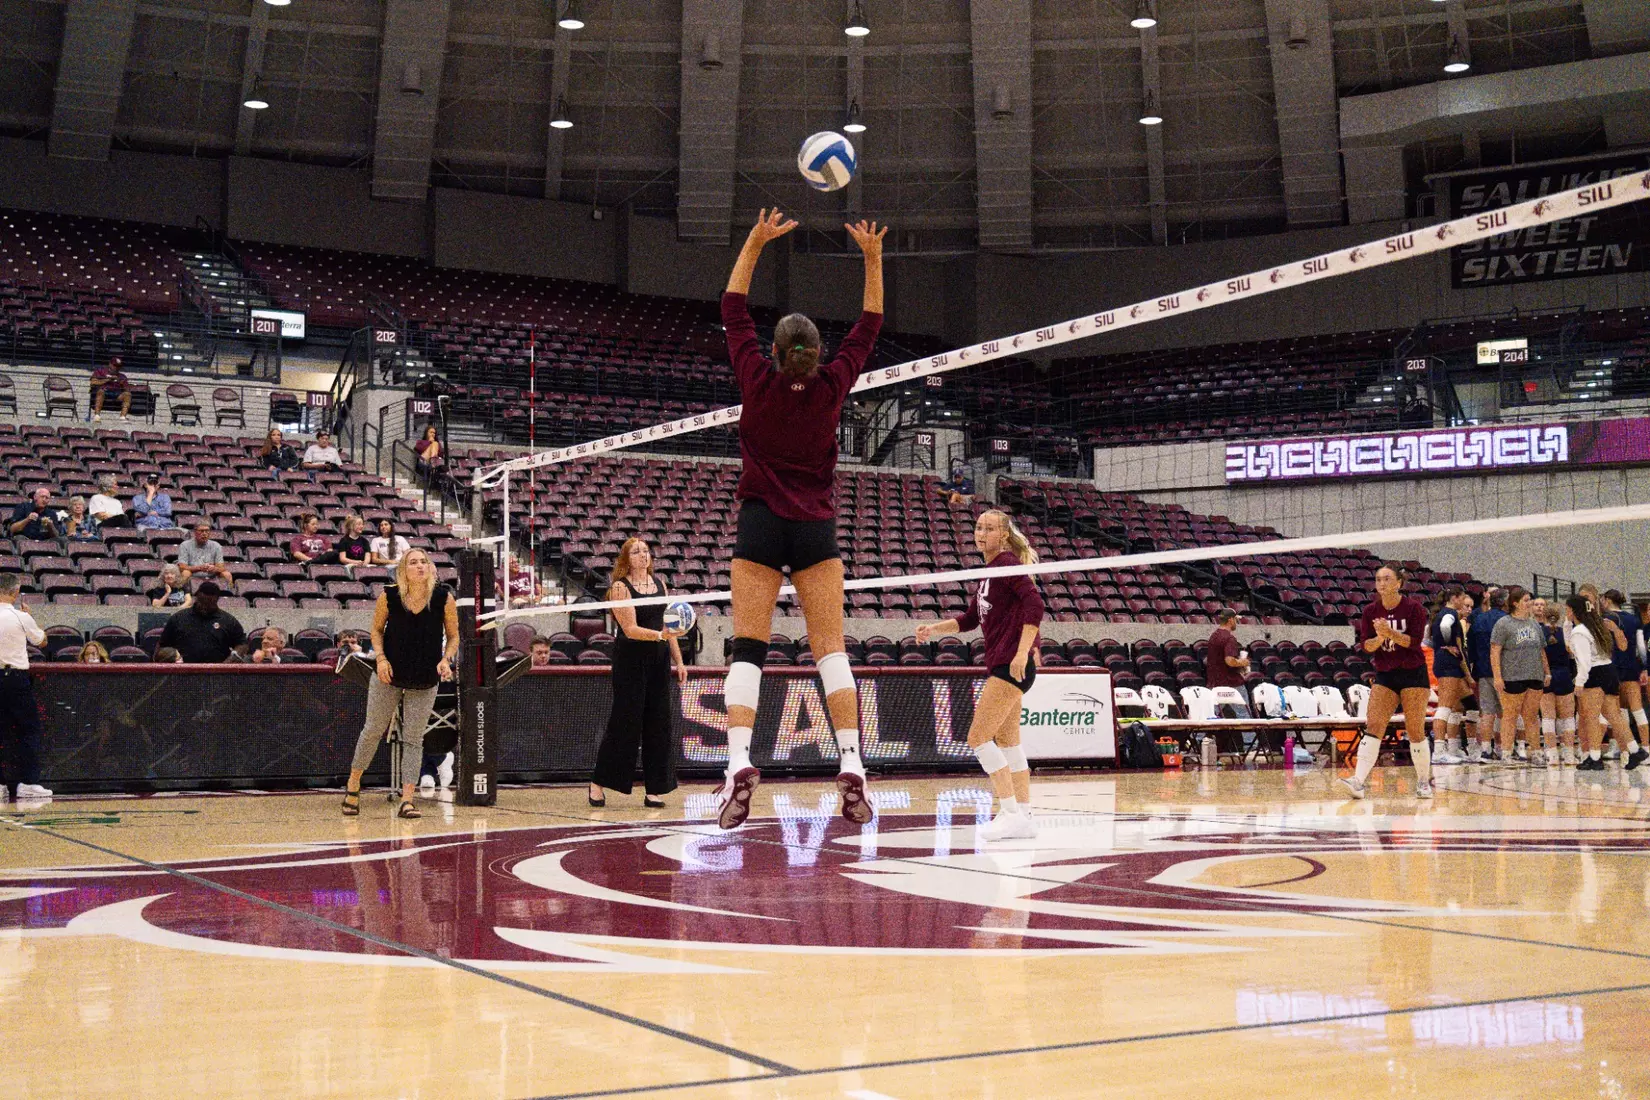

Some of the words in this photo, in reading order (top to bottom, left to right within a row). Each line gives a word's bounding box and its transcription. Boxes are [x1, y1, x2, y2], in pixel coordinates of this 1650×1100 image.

[1577, 183, 1613, 206] SIU
[1476, 211, 1508, 231] SIU
[1385, 234, 1415, 254] SIU
[1303, 256, 1329, 276] SIU
[1461, 242, 1633, 283] SIXTEEN
[1227, 277, 1251, 295] SIU
[1158, 296, 1180, 312] SIU
[256, 320, 275, 333] 201
[281, 320, 302, 330] terra
[1095, 312, 1115, 328] SIU
[376, 331, 396, 343] 202
[1035, 327, 1055, 343] SIU
[981, 341, 1000, 355] SIU
[931, 355, 948, 368] SIU
[1503, 351, 1524, 362] 204
[1406, 359, 1426, 371] 203
[885, 366, 900, 380] SIU
[926, 376, 942, 387] 203
[311, 394, 327, 406] 101
[413, 401, 431, 413] 102
[726, 407, 740, 418] SIU
[693, 415, 706, 427] SIU
[631, 429, 643, 441] SIU
[662, 423, 673, 434] SIU
[917, 434, 932, 446] 102
[993, 439, 1008, 450] 103
[476, 701, 485, 729] sports
[1019, 707, 1095, 726] Banterra
[1063, 727, 1096, 735] CENTER
[476, 729, 485, 764] imports
